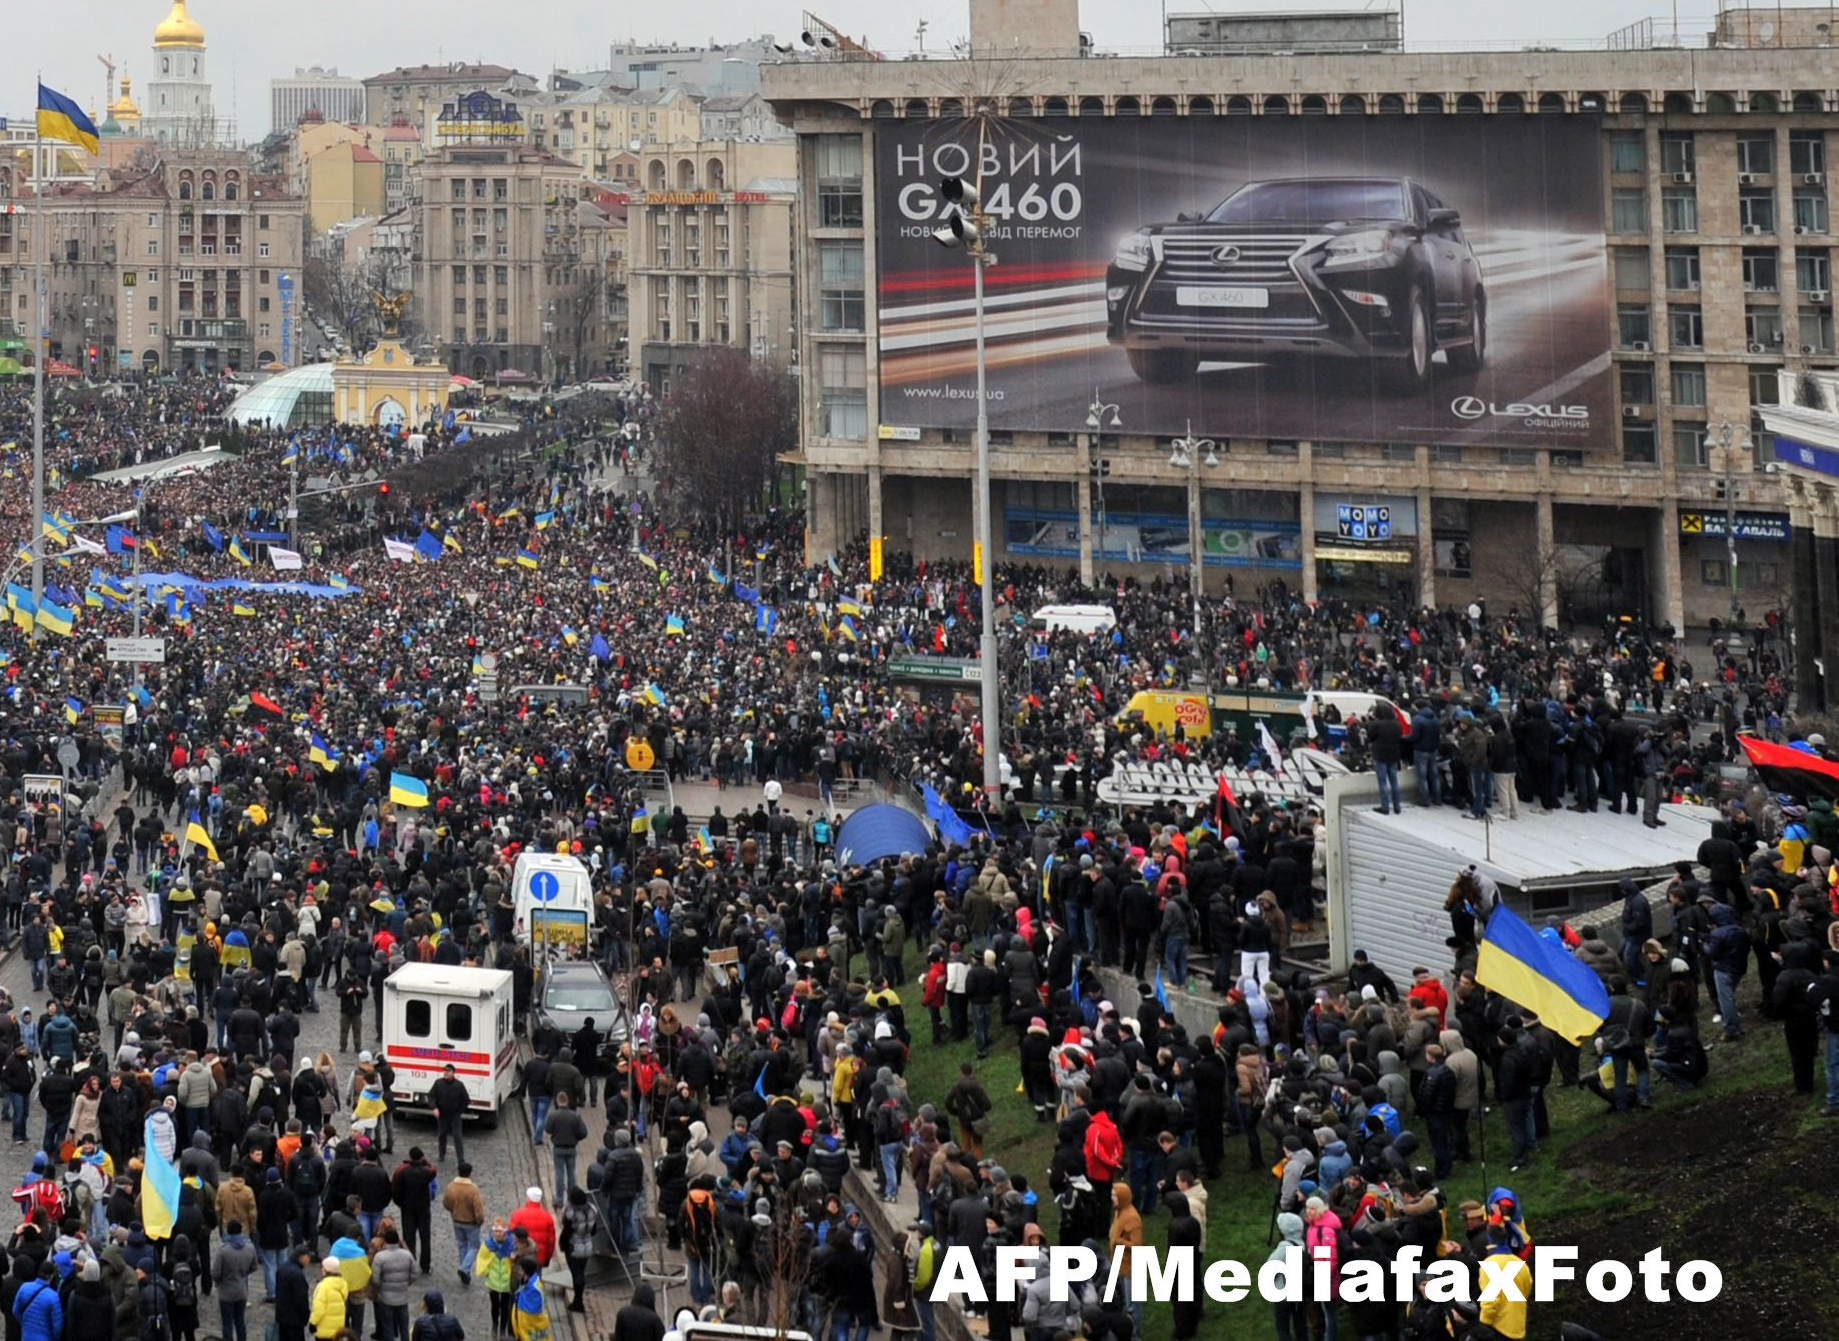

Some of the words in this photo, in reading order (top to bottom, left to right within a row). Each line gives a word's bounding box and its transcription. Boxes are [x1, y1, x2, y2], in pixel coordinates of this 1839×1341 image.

[897, 135, 1081, 176] НОВИЙ
[984, 182, 1082, 220] 460
[1017, 226, 1082, 239] ПЕРЕМОГ
[1199, 291, 1218, 303] GX
[904, 384, 1004, 400] www.lexusua
[1490, 403, 1589, 418] LEXUS
[1524, 418, 1589, 429] ОФІЦІЙНИЙ
[1704, 515, 1782, 525] Райфайзен
[1742, 526, 1785, 537] АВАЛЬ
[411, 1070, 427, 1079] 103
